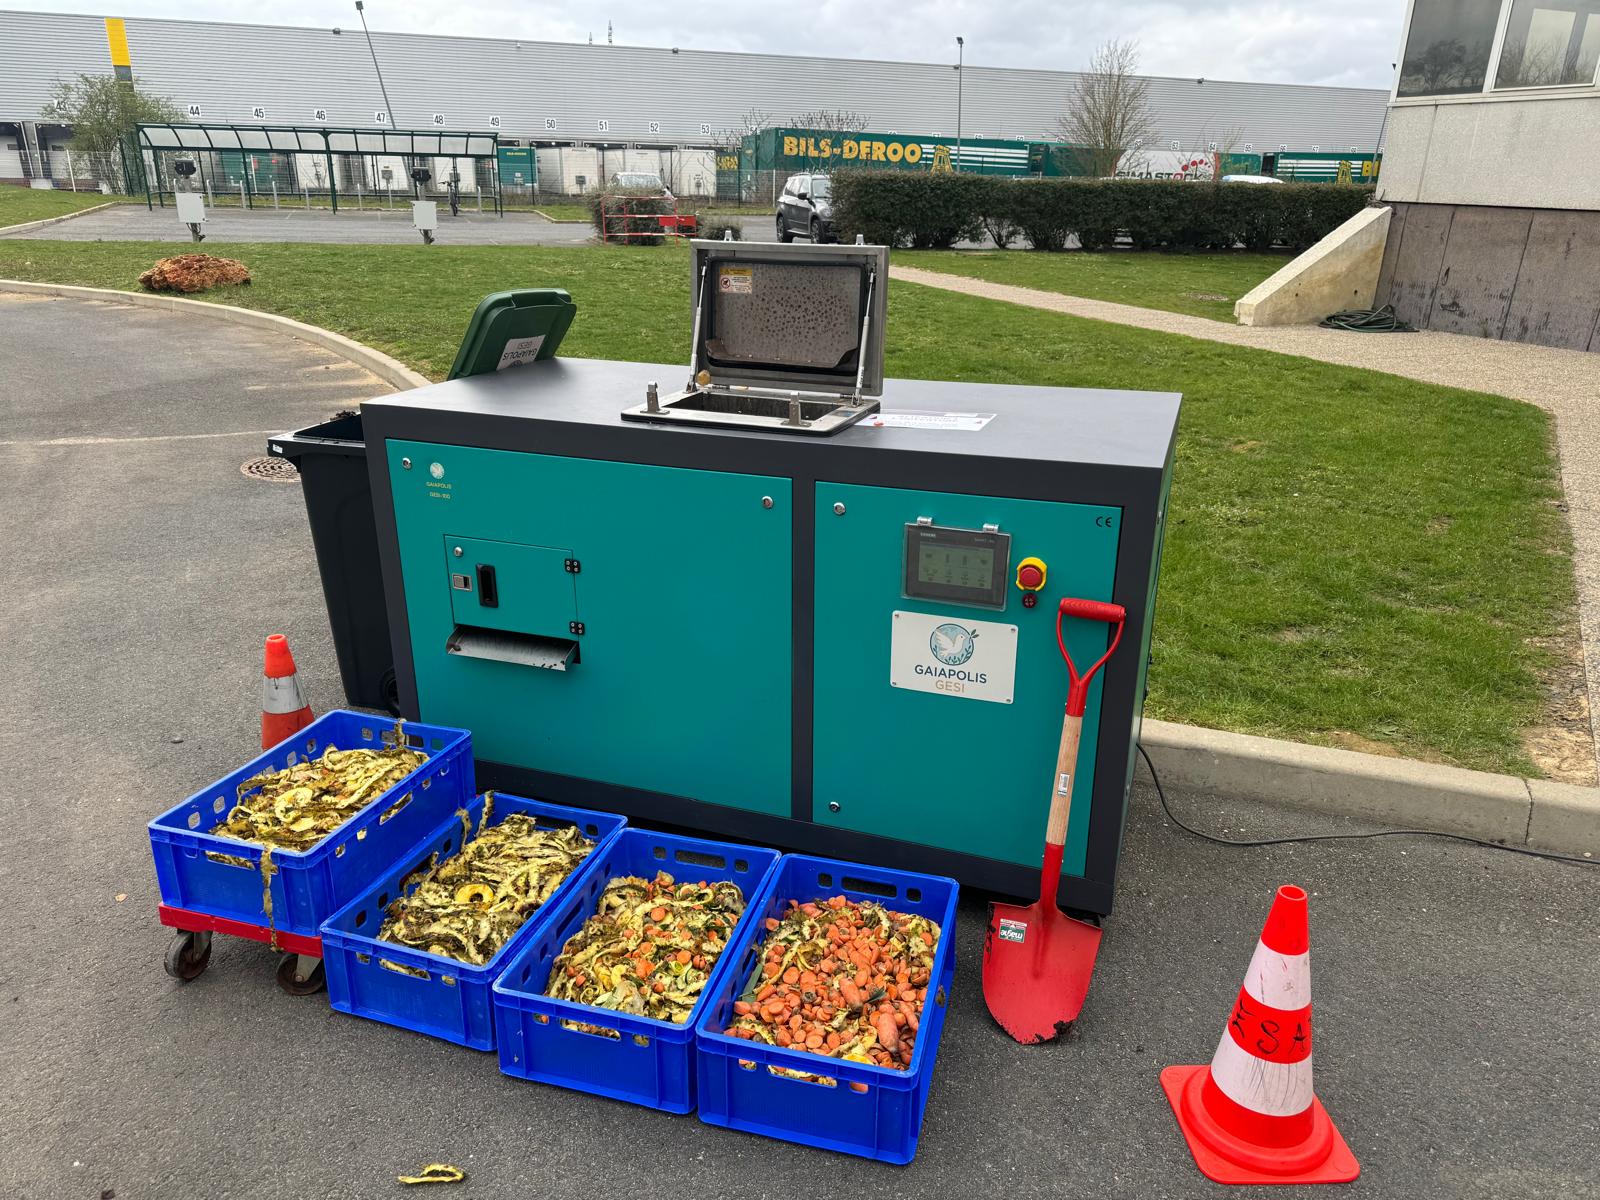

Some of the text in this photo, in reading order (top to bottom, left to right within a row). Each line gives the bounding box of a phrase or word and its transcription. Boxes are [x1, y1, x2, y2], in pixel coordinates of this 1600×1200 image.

[189, 105, 200, 116] 44
[253, 107, 265, 118] 45
[315, 110, 326, 121] 46
[376, 112, 386, 123] 47
[434, 114, 444, 125] 48
[490, 116, 500, 127] 49
[546, 119, 556, 129] 50
[599, 121, 608, 131] 51
[650, 122, 659, 132] 52
[701, 124, 710, 134] 53
[1096, 516, 1113, 528] CE
[914, 664, 987, 684] GAIAPOLIS
[935, 679, 965, 693] GESI
